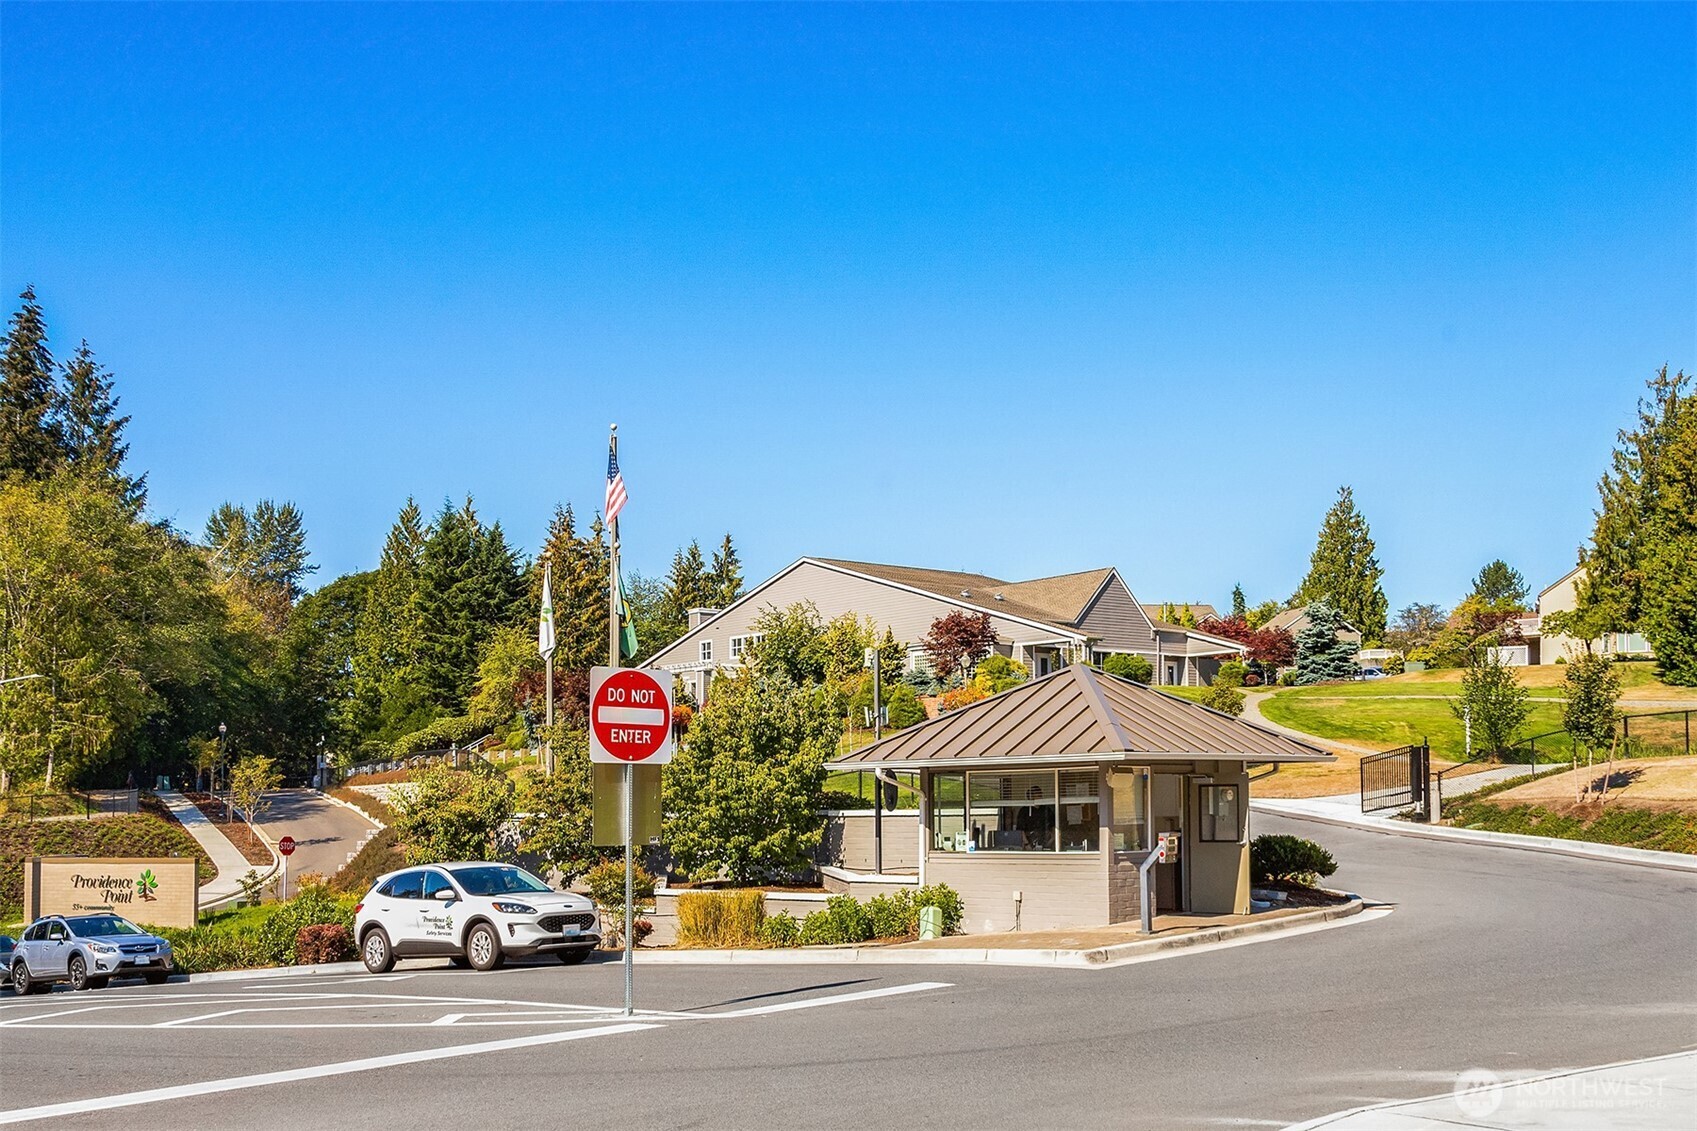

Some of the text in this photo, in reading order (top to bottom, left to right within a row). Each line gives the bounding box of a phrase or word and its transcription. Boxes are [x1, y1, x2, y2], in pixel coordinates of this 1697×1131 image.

[608, 688, 656, 704] DO NOT
[611, 728, 651, 744] ENTER
[280, 842, 294, 850] STOP
[71, 874, 133, 889] Providence
[100, 890, 133, 903] Point
